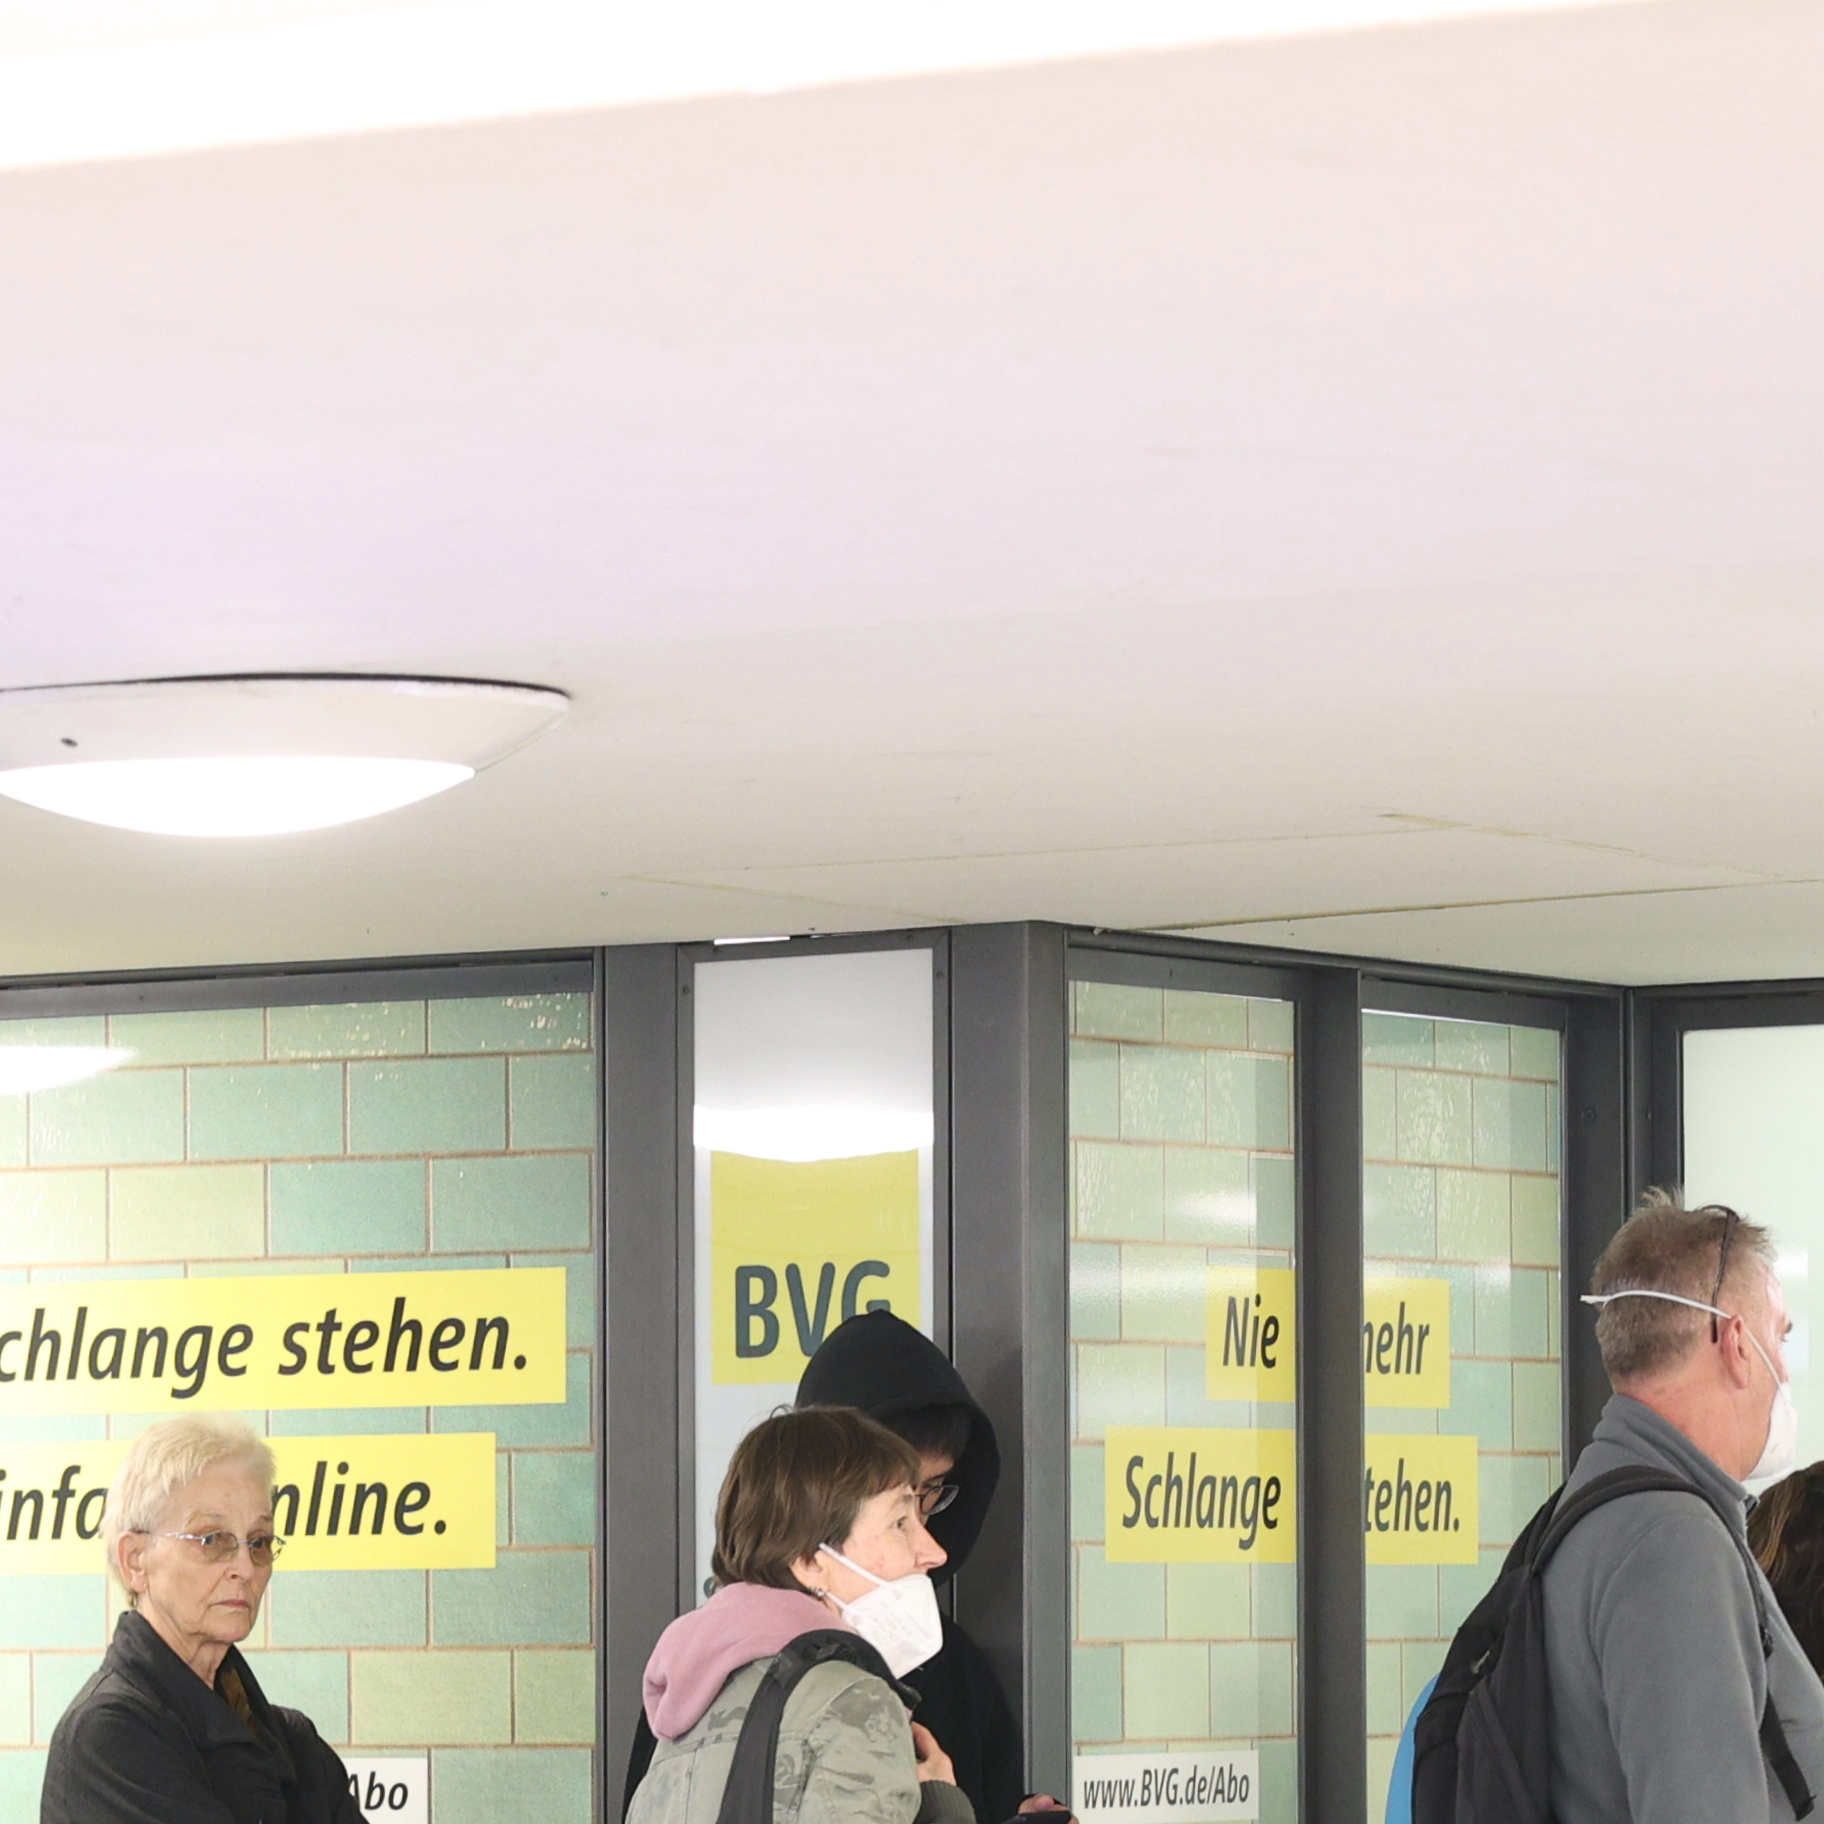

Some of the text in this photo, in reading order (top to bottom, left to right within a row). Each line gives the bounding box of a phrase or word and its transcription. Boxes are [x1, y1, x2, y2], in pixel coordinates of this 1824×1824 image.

[277, 1296, 529, 1377] stehen.
[735, 1259, 891, 1359] BVG
[1222, 1293, 1430, 1376] Nie ehr
[272, 1460, 448, 1537] nline.
[1121, 1451, 1460, 1551] Schlange tehen.
[1083, 1763, 1250, 1810] www.BVG.de/Abo
